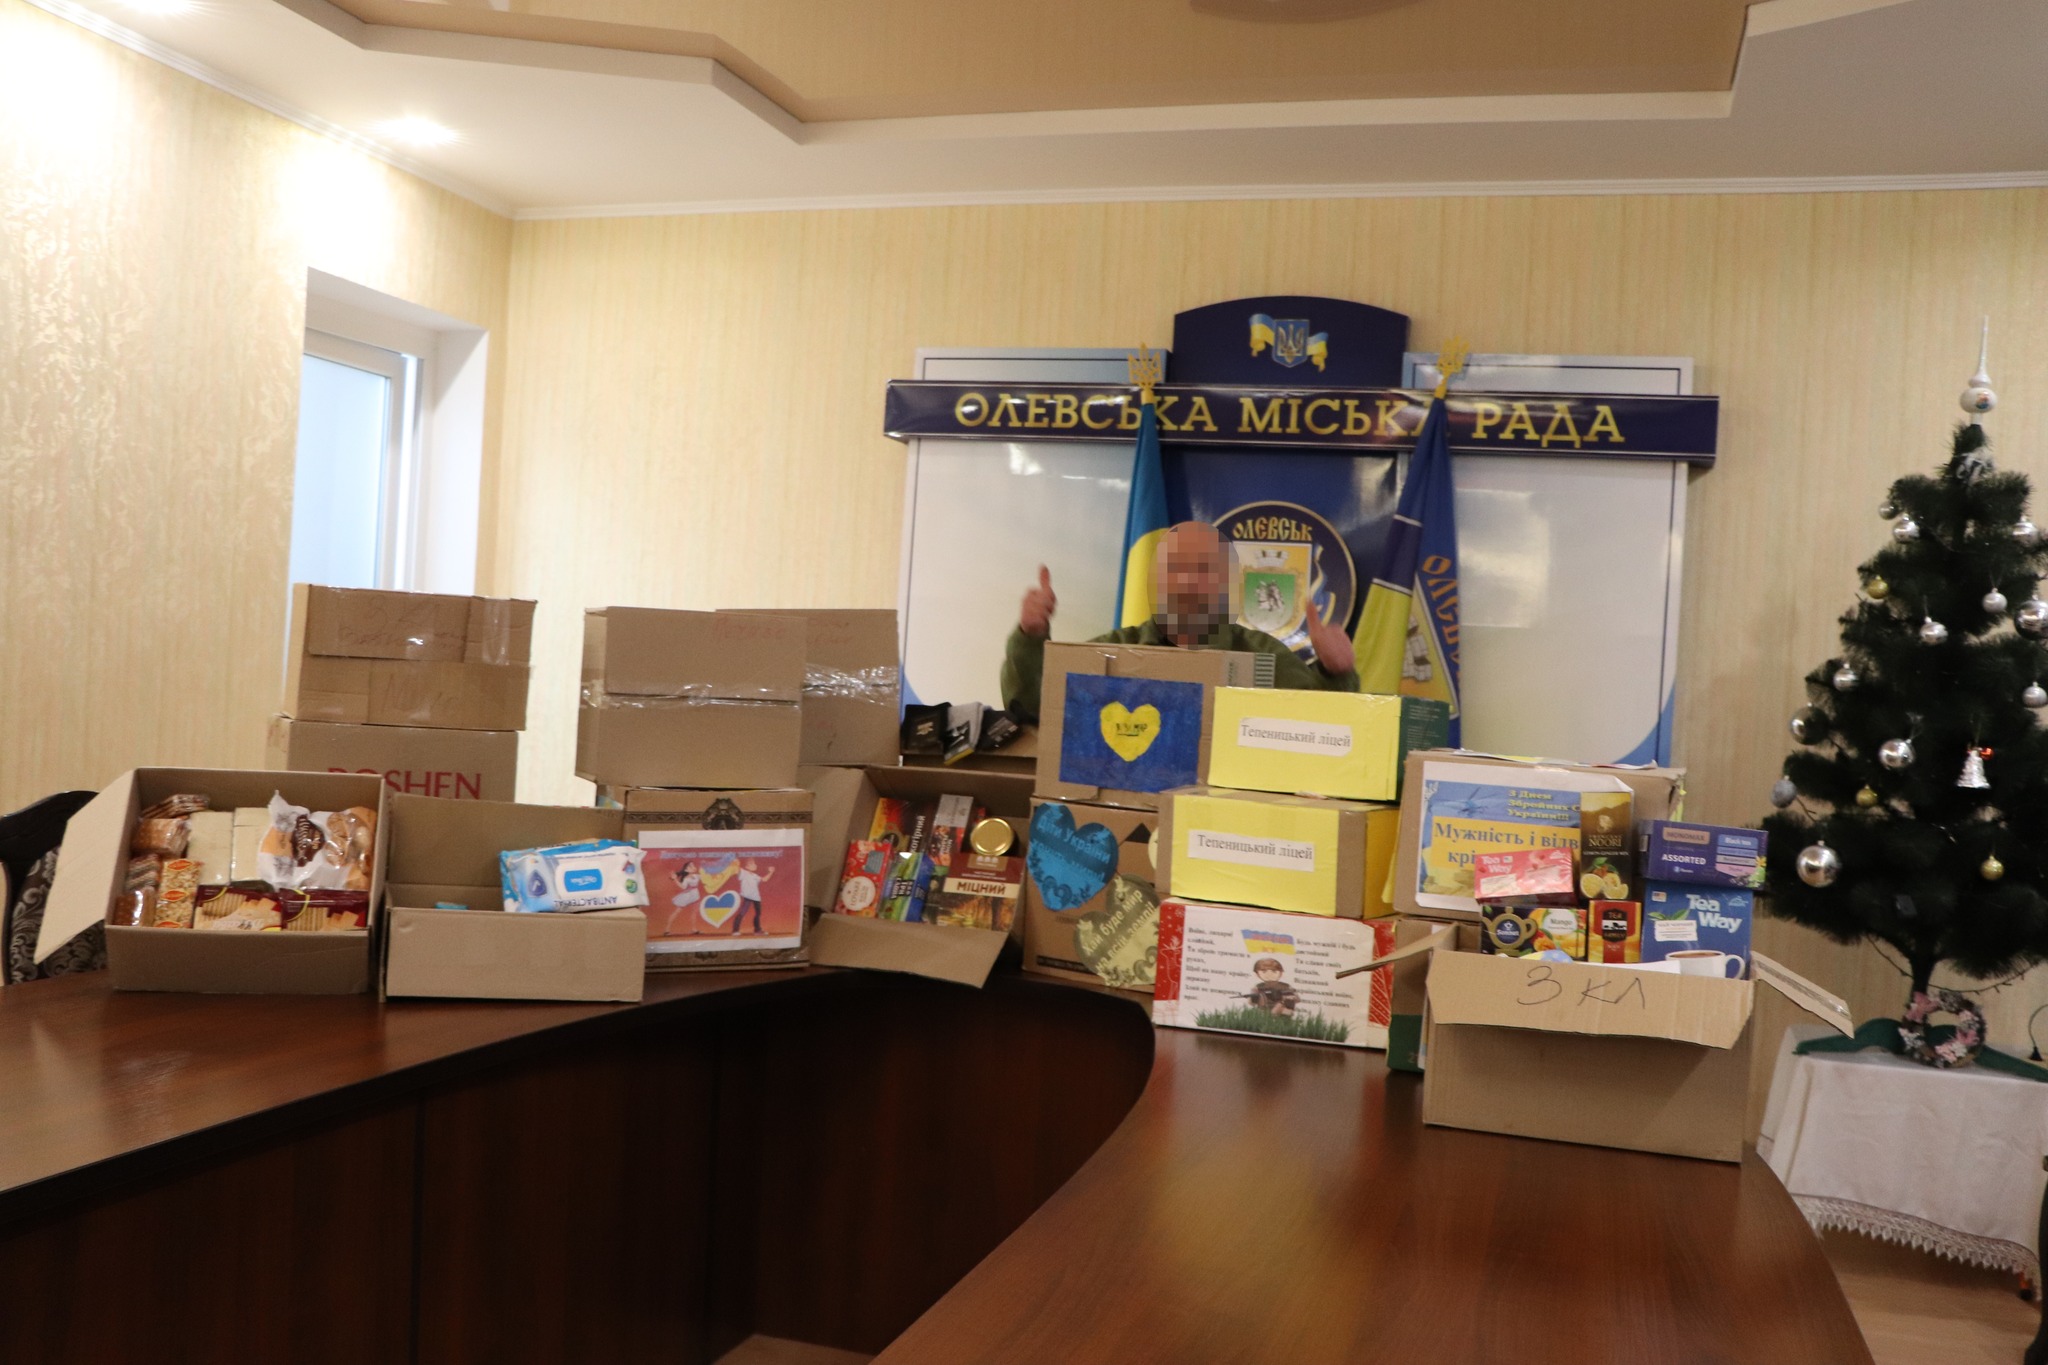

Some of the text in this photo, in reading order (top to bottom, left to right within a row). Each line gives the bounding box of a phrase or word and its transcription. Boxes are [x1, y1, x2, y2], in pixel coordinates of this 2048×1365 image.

[955, 392, 1218, 432] ОЛЕВСЬКА
[1472, 402, 1626, 449] РАДА
[1241, 724, 1351, 748] Тепеницький ліцей
[1433, 822, 1524, 846] Мужність
[1529, 831, 1535, 846] і
[1197, 834, 1313, 859] Тепеницький ліцей
[1662, 853, 1707, 865] ASSORTED
[957, 881, 1006, 895] МІЦНИЙ
[1101, 906, 1125, 936] буде
[1124, 889, 1143, 912] мир
[1686, 893, 1720, 912] Tea
[1698, 911, 1743, 933] Way
[1517, 965, 1562, 1005] 3
